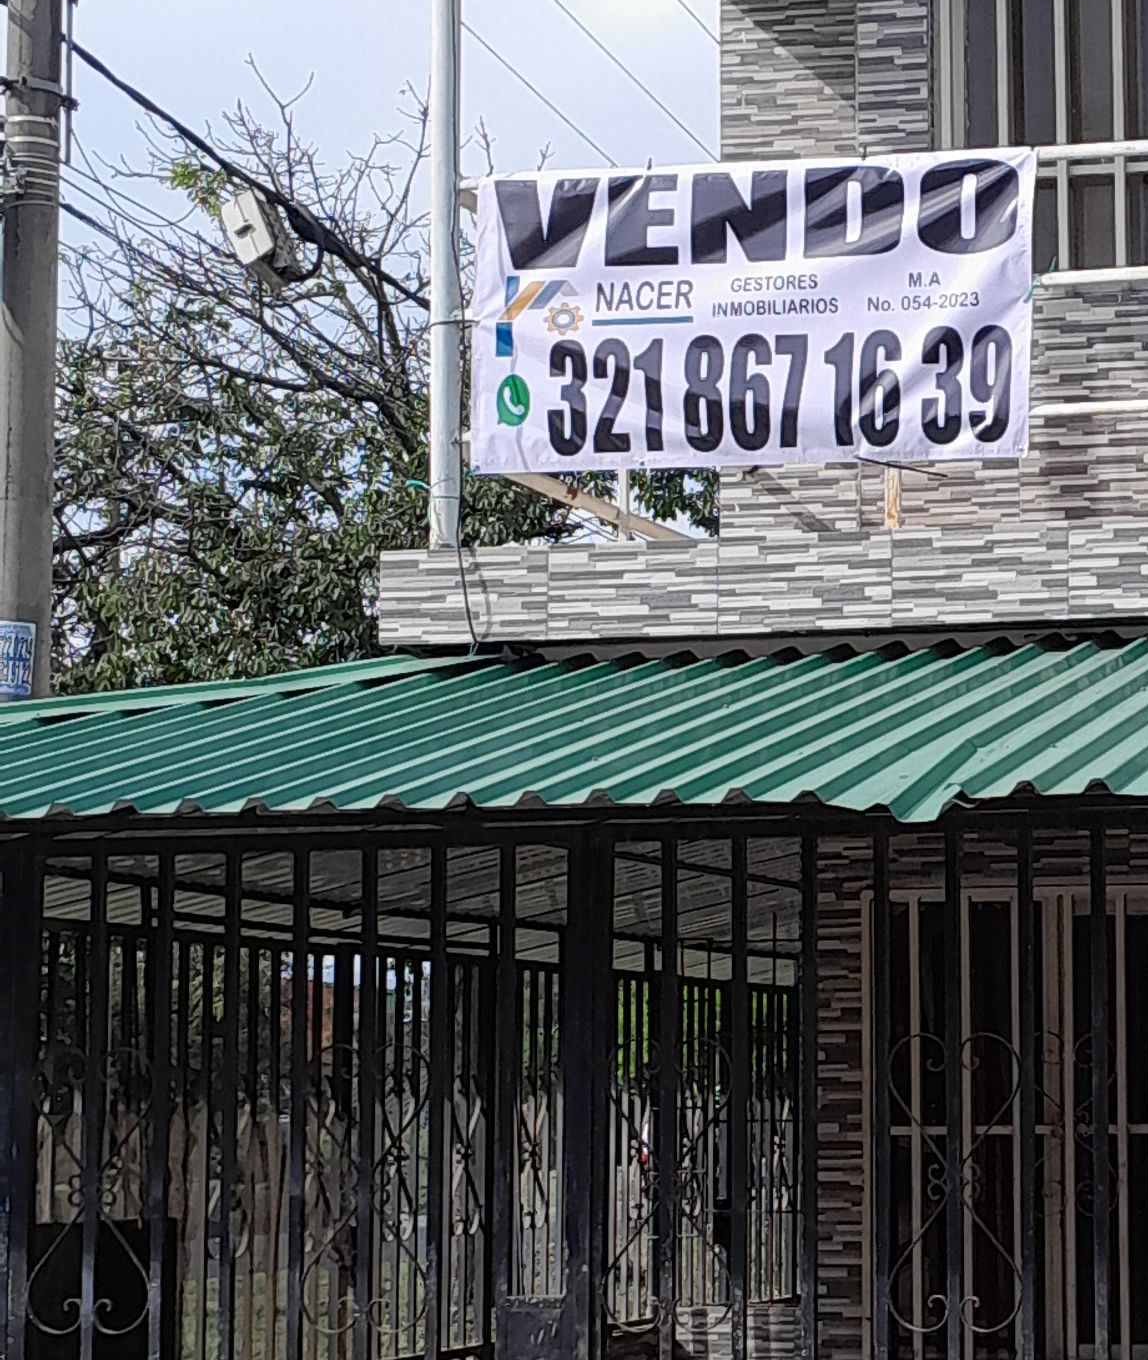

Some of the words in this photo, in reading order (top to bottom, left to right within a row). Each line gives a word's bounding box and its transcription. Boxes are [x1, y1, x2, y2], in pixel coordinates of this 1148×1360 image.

[493, 159, 1020, 270] VENDO
[595, 279, 693, 312] NACER
[731, 274, 819, 293] GESTORES
[712, 297, 839, 317] INMOBILIARIOS
[867, 296, 895, 312] No.
[901, 292, 980, 311] 054-2023
[546, 338, 664, 456] 321
[683, 332, 809, 453] 867
[824, 330, 901, 447] 16
[920, 324, 1012, 445] 39
